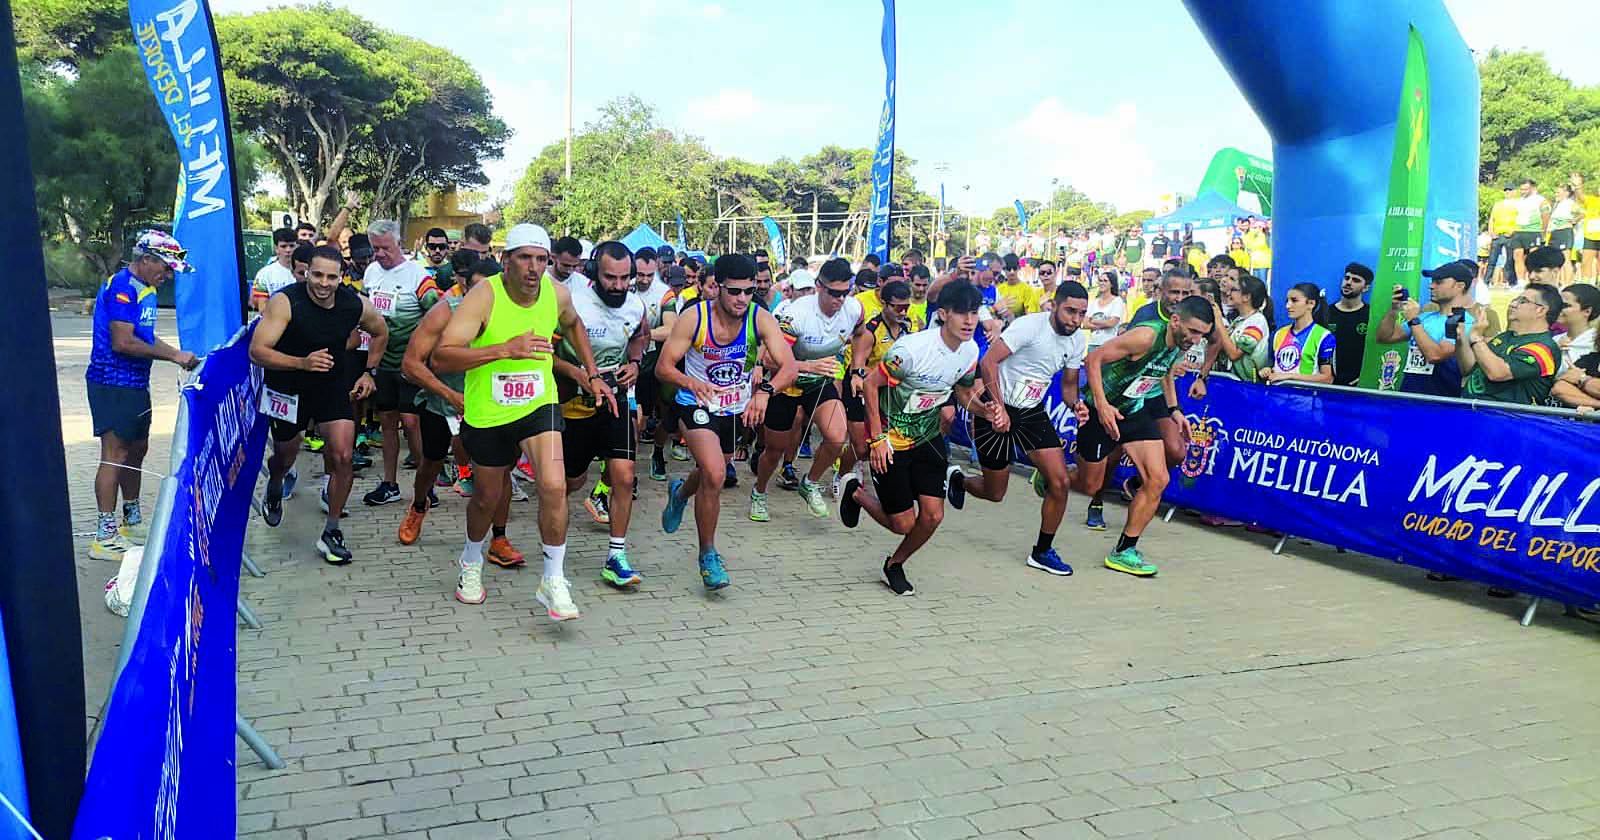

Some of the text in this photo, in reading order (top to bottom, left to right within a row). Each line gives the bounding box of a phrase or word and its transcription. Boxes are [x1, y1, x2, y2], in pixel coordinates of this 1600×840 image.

[1437, 217, 1461, 258] LA
[373, 298, 392, 311] 1037
[503, 382, 536, 398] 984
[718, 391, 741, 407] 704
[270, 397, 289, 416] 774
[1234, 428, 1380, 466] CIUDAD AUTÓNOMA
[1243, 448, 1252, 457] DE
[1228, 446, 1369, 508] MELILLA
[1407, 454, 1600, 533] MELILL
[1402, 512, 1600, 573] CIUDAD DEL DEPOR
